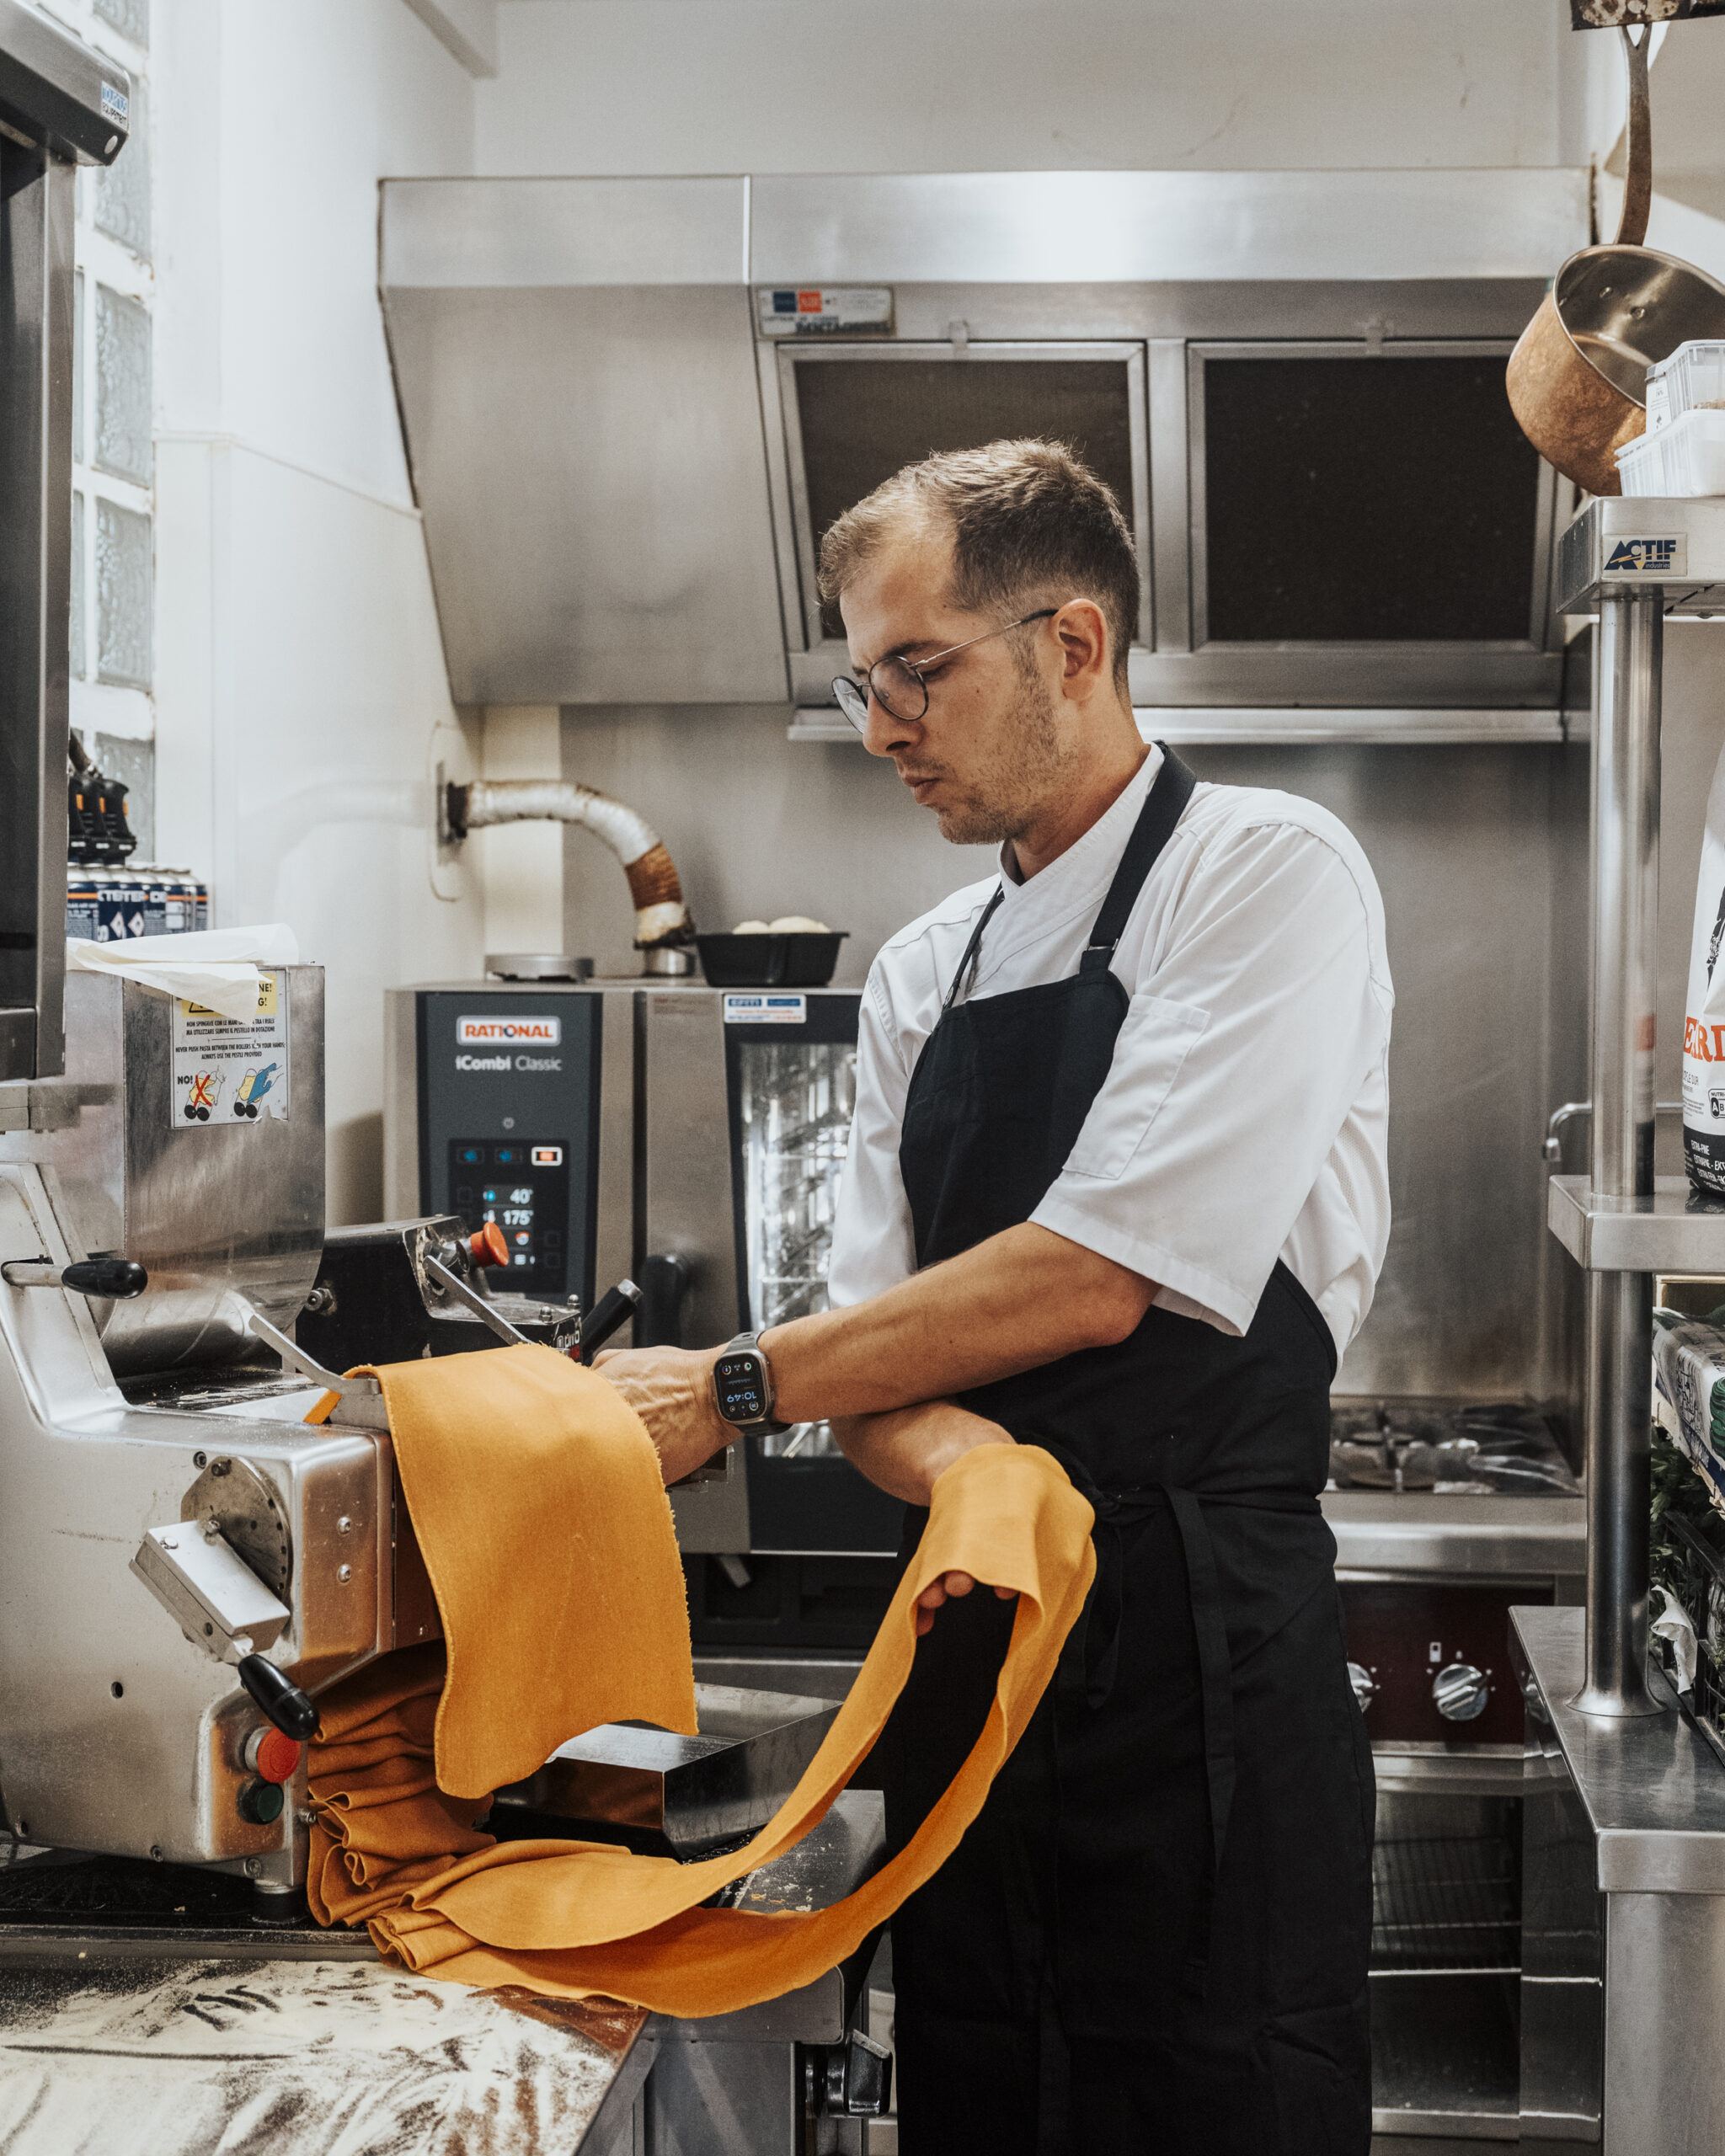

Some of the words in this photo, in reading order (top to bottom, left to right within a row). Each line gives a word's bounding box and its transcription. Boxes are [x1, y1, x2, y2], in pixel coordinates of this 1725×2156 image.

[1604, 540, 1676, 570] ACTIF
[465, 1024, 553, 1038] RATIONAL
[456, 1054, 512, 1071] iCombi
[515, 1054, 563, 1071] Classic
[177, 1075, 194, 1085] NO!
[1719, 1103, 1725, 1112] B
[727, 1391, 756, 1403] 10:49
